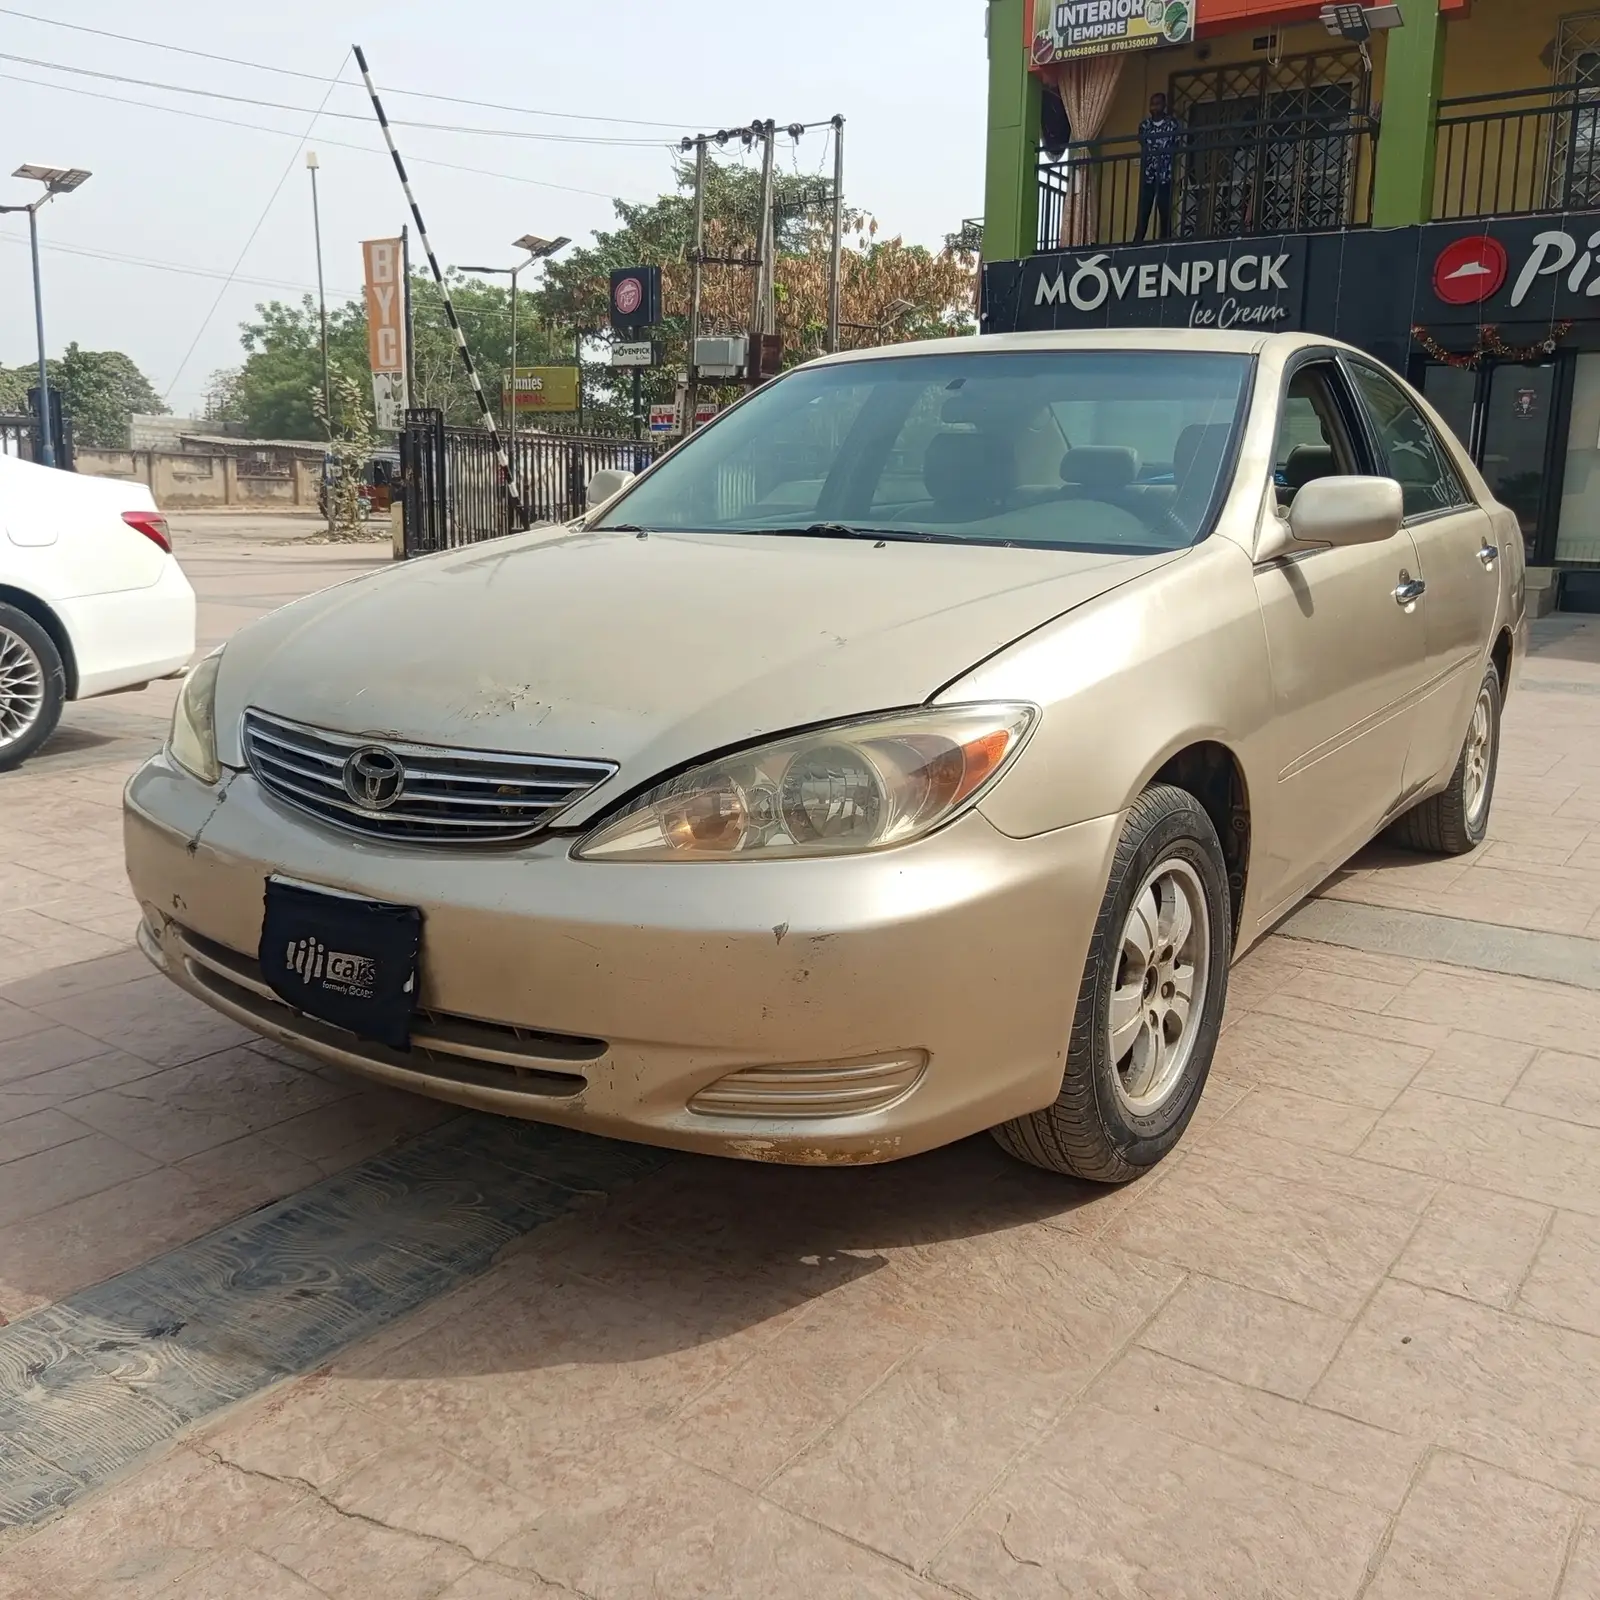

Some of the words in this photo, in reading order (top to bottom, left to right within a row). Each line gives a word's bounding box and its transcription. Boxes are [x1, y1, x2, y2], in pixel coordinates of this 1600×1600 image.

[1058, 0, 1144, 28] INTERIOR
[1073, 21, 1126, 41] EMPIRE
[1188, 300, 1216, 327] Ice
[1218, 297, 1286, 329] Cream
[331, 957, 377, 984] cars
[322, 980, 348, 995] formerly
